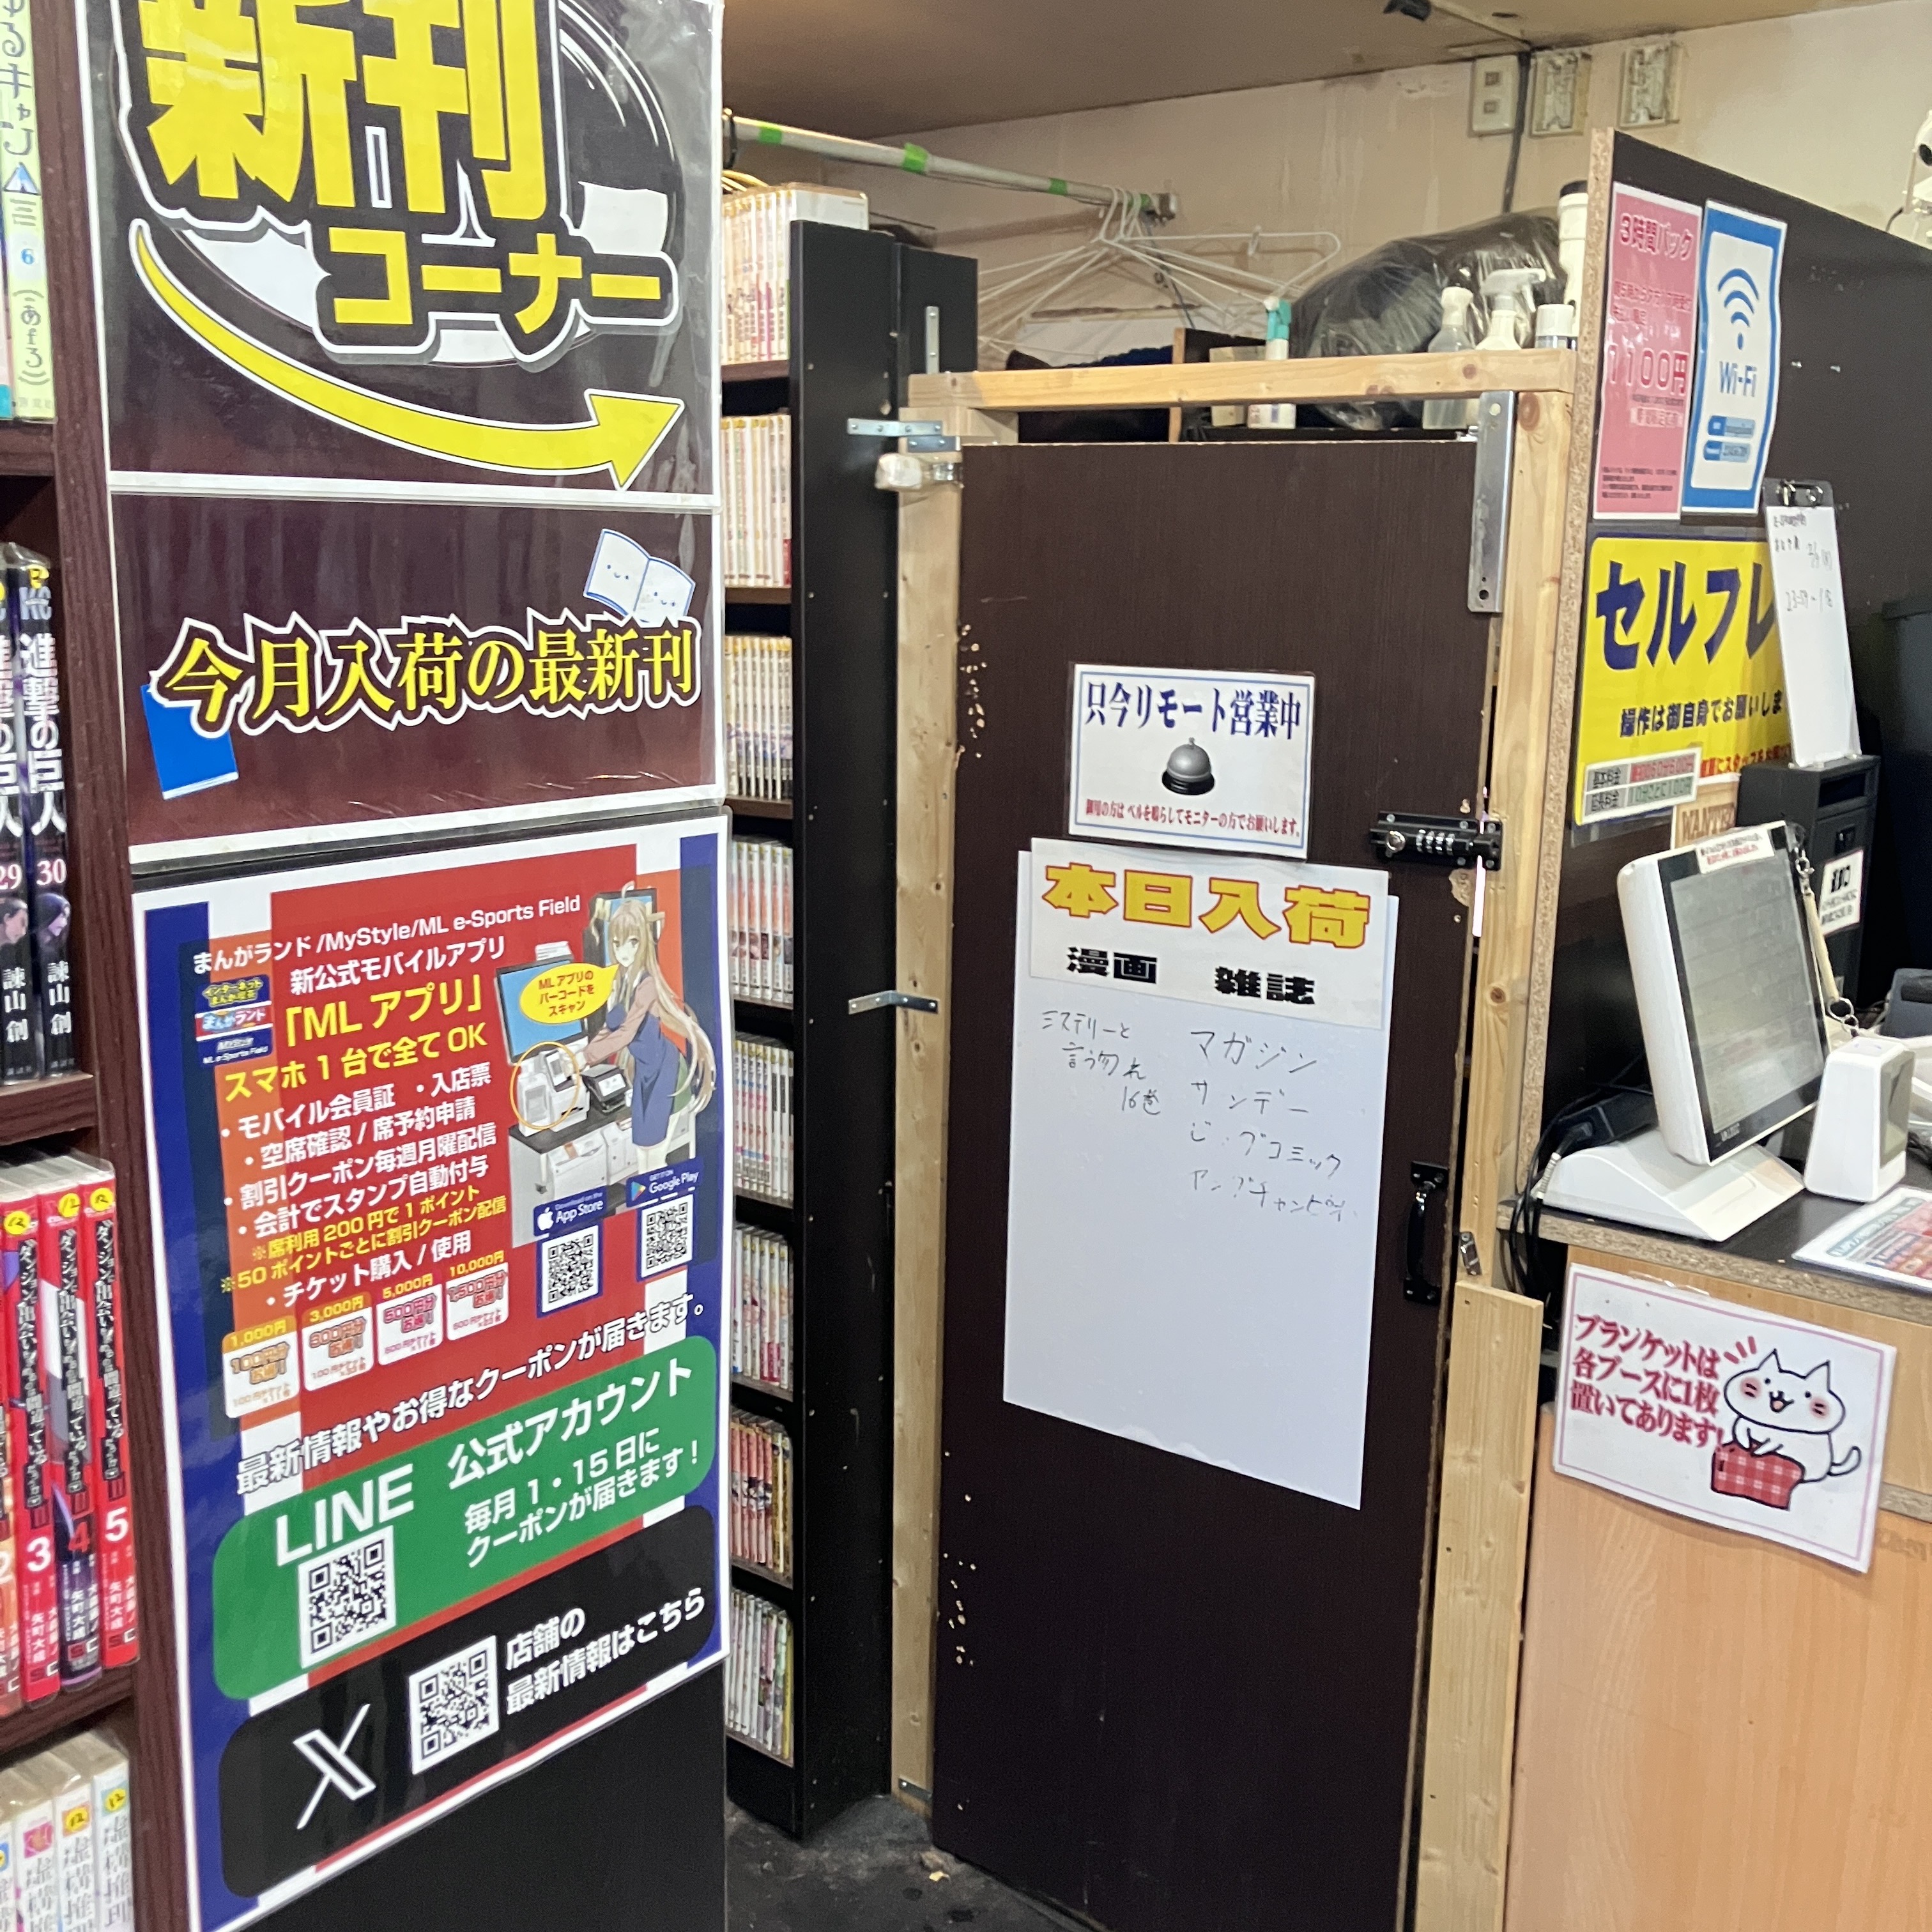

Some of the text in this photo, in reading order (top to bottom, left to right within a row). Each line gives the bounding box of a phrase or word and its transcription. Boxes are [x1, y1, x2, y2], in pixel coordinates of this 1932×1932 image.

[137, 0, 548, 219] 新刊
[20, 248, 35, 266] 6
[328, 226, 661, 334] コーナー
[1719, 361, 1757, 397] Wi-Fi
[166, 628, 694, 723] 今月入荷の最新刊
[1085, 681, 1301, 740] 只今リモート営業中
[19, 632, 67, 836] 進撃の巨人
[36, 858, 68, 886] 30
[1041, 861, 1371, 949] 本日入荷
[193, 935, 311, 974] まんがランド
[453, 903, 534, 933] e-Sports
[539, 894, 581, 918] Field
[289, 935, 507, 995] 新公式モバイルアプリ
[1066, 946, 1158, 985] 漫画
[1214, 965, 1316, 1005] 雑誌
[548, 1000, 586, 1017] スキャン
[1190, 1030, 1317, 1075] マガジン
[1190, 1081, 1310, 1115] サンデー
[648, 1177, 681, 1194] Google
[681, 1171, 700, 1185] Play
[555, 1208, 578, 1224] App
[578, 1200, 604, 1216] Store
[449, 1250, 504, 1277] 10,000円
[382, 1273, 434, 1300] 5,000円
[309, 1296, 364, 1323] 3,000円
[230, 1319, 287, 1347] 1,000円
[1574, 1314, 1721, 1378] ブランケットは
[236, 1292, 704, 1496] 最新情報やお得なクーポンが届きます。
[1571, 1347, 1721, 1418] 各ブースに1枚
[448, 1357, 693, 1490] 公式アカウント
[105, 1507, 128, 1542] 5
[275, 1462, 415, 1567] LINE
[26, 1536, 50, 1572] 3
[68, 1521, 90, 1554] 4
[505, 1607, 585, 1671] 店舗の
[506, 1588, 705, 1715] 最新情報はこちら
